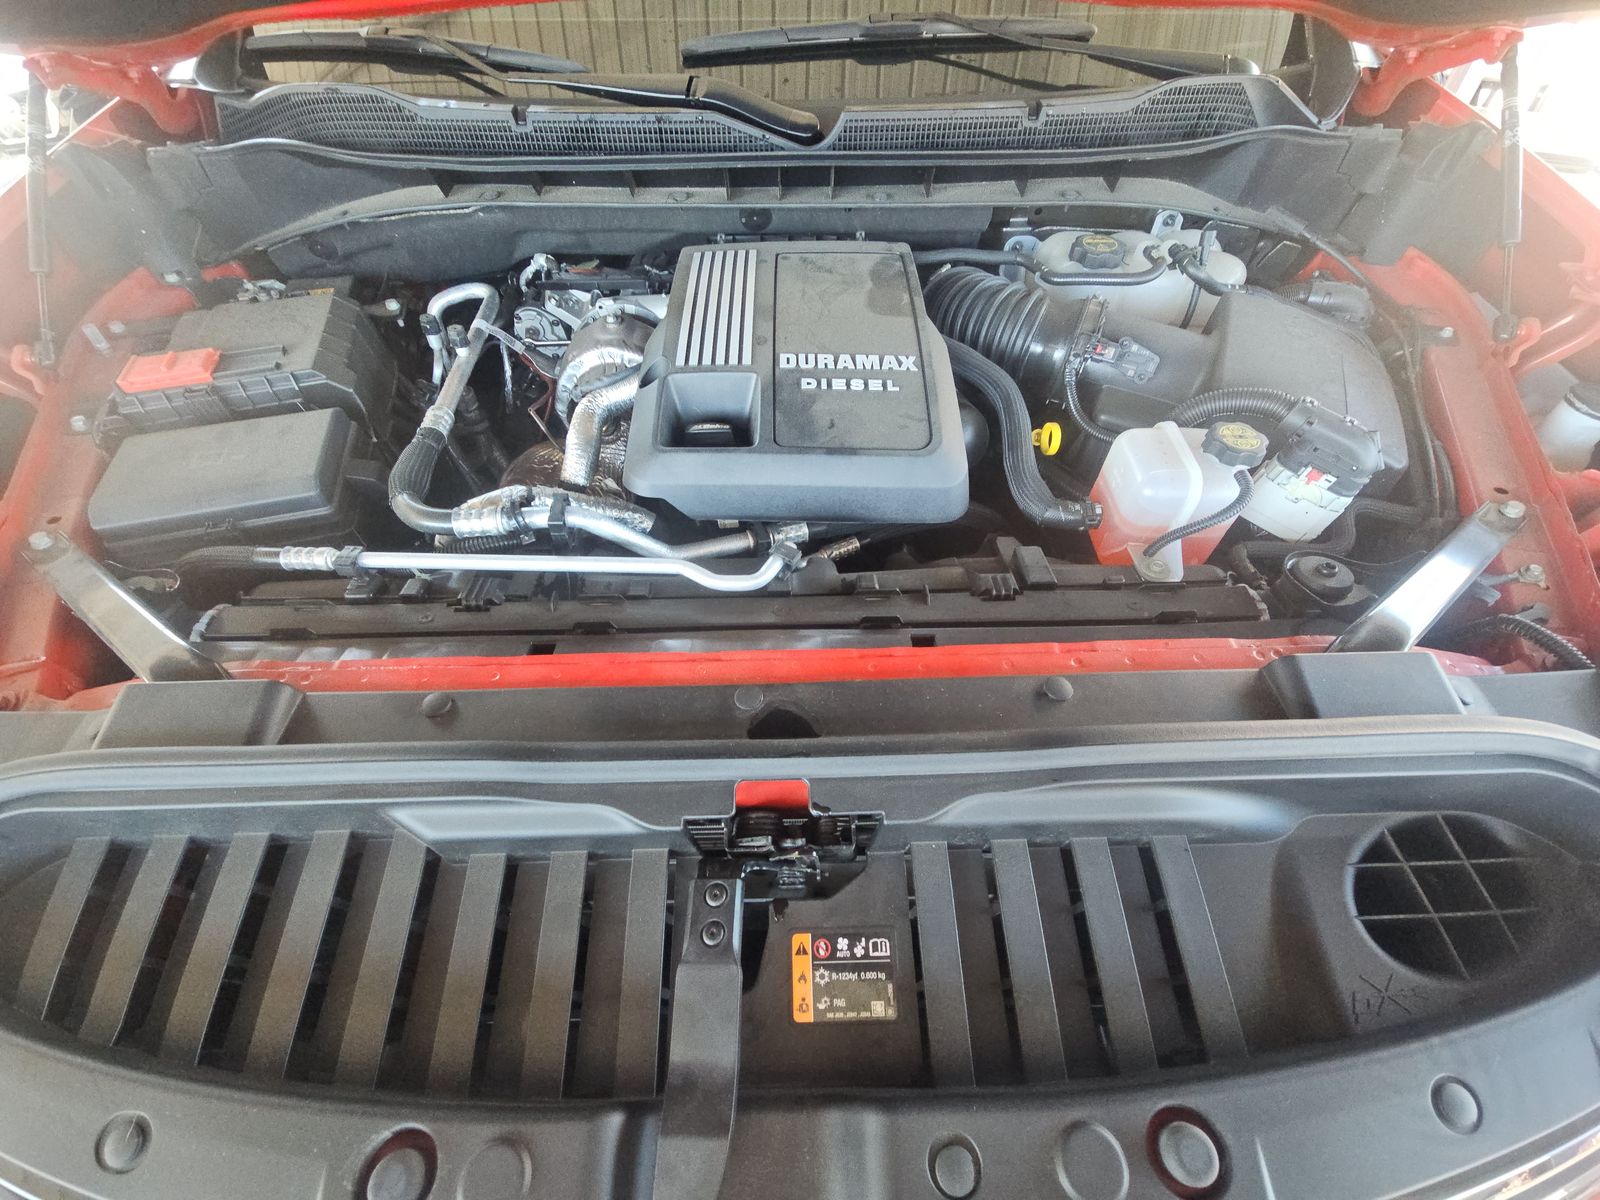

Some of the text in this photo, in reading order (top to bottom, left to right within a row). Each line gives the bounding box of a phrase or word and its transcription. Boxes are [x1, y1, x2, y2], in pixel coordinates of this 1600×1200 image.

[779, 352, 918, 371] DURAMAX
[801, 377, 900, 392] DIESEL
[836, 950, 851, 958] AUTO
[831, 971, 858, 982] R-1234yf
[878, 970, 886, 981] kg
[833, 998, 846, 1008] PAG
